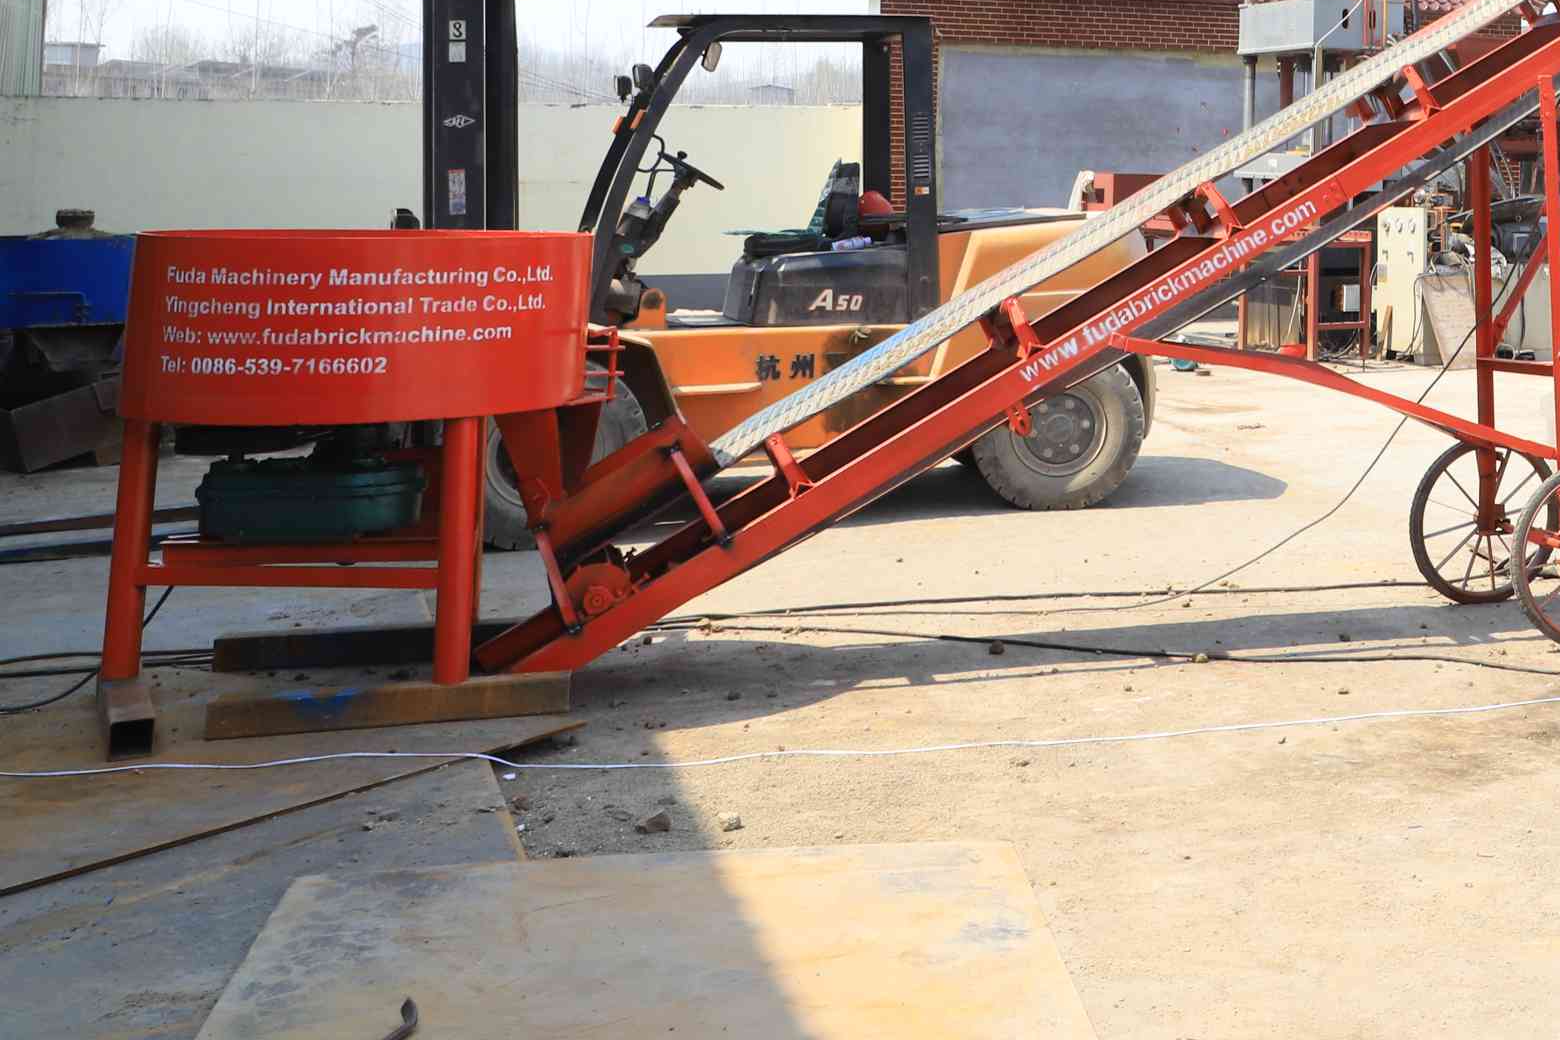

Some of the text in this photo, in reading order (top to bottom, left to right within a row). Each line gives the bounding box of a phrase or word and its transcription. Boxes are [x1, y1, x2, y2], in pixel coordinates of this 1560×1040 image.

[167, 265, 553, 289] Fuda Machinery Manufacturing Co.,Ltd.
[165, 293, 546, 319] Yingcheng International Trade Co.,Ltd.
[162, 325, 513, 346] Web: www.fudabrickmachine.com
[160, 356, 388, 375] Tel: 0086-539-7166602
